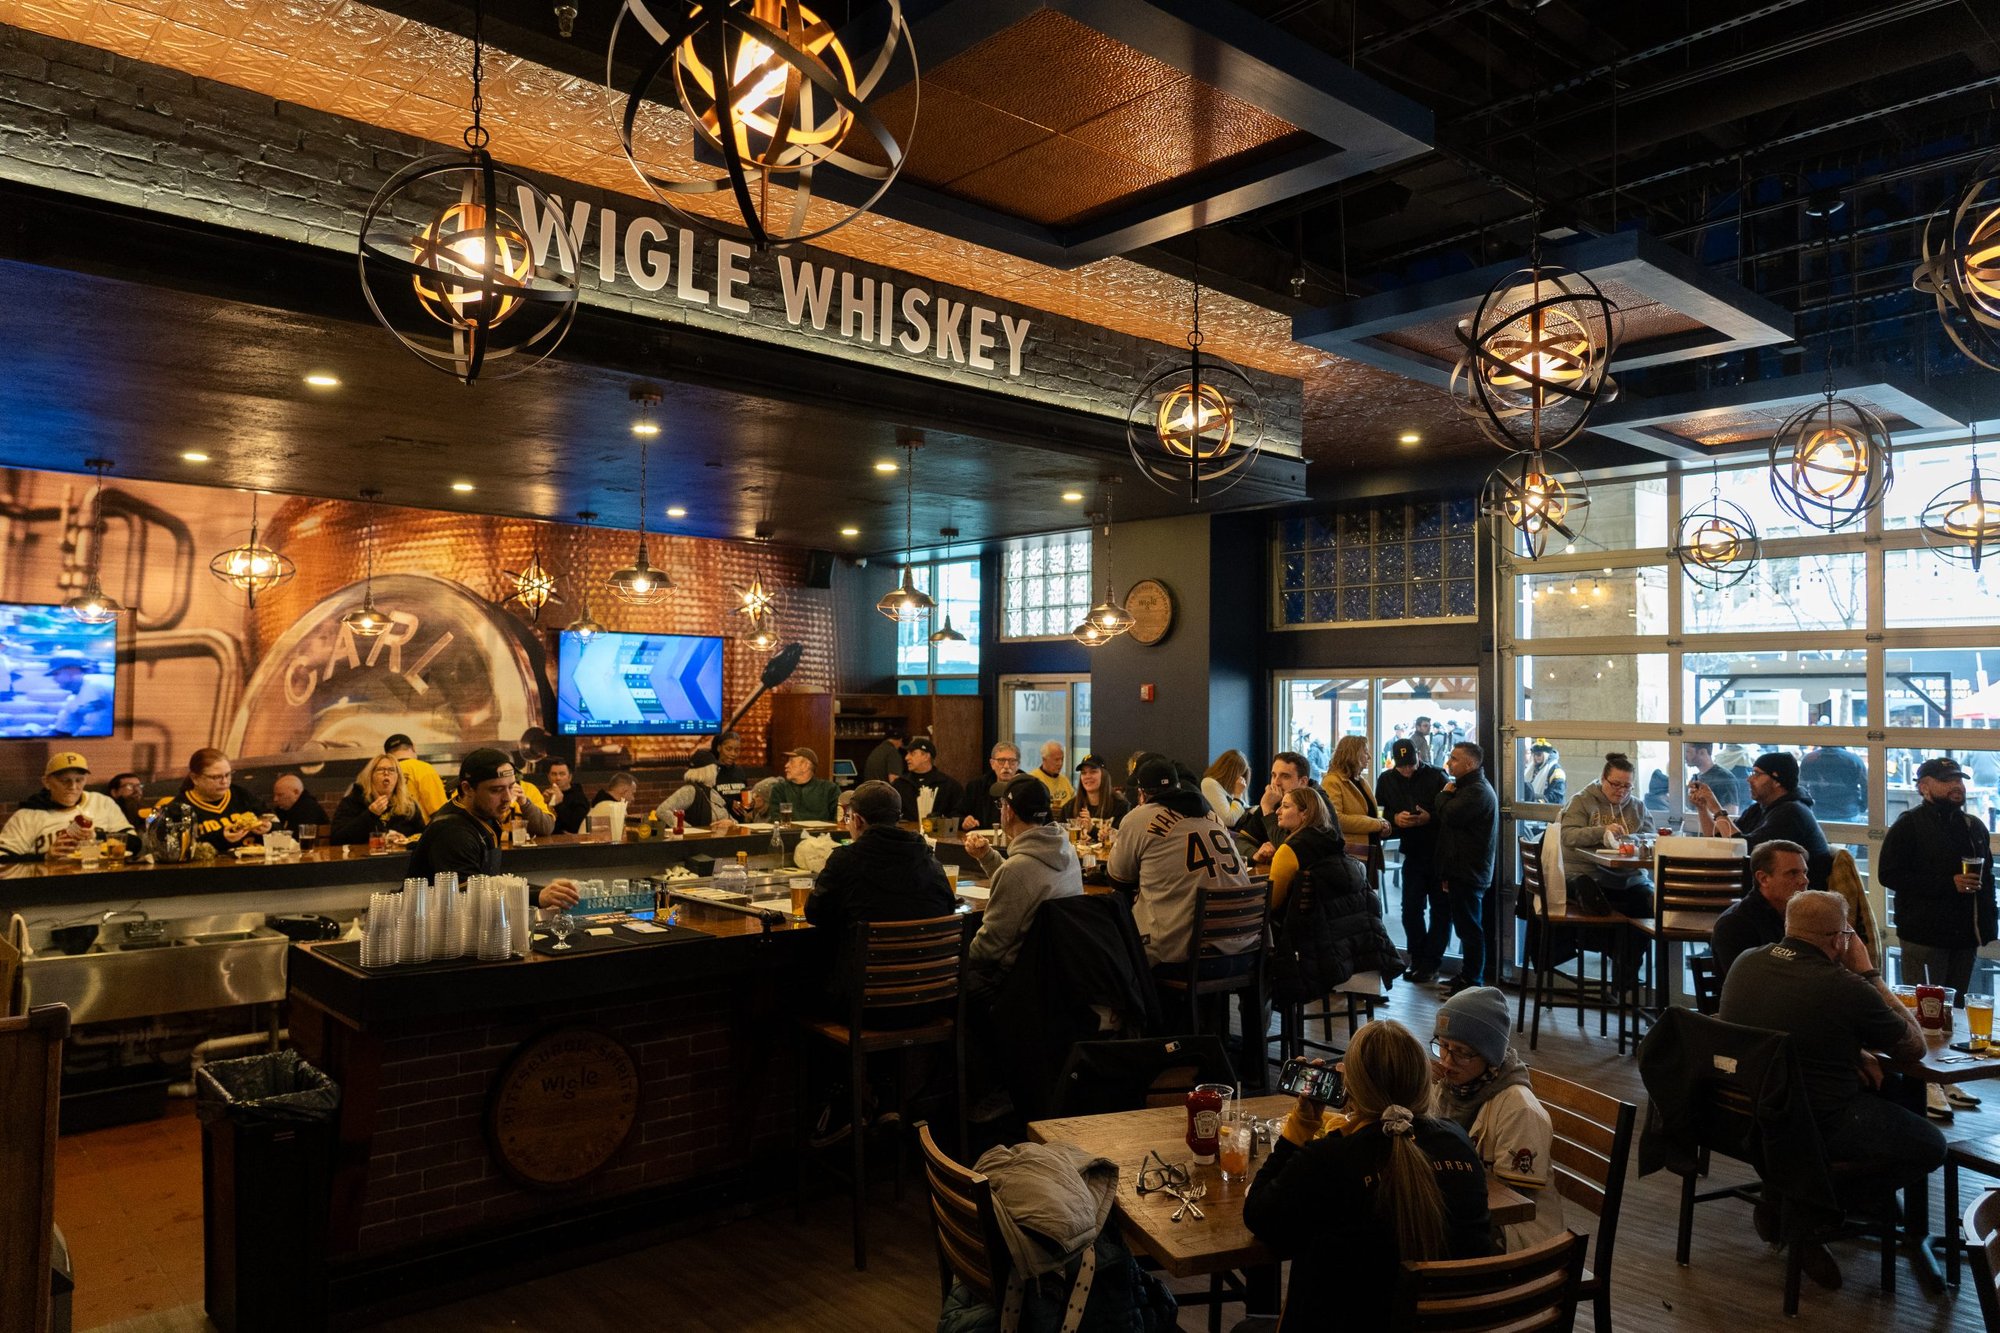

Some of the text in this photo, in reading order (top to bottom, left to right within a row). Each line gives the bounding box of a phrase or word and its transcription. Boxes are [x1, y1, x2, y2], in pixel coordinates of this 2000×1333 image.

[516, 184, 1031, 377] WIGLE WHISKEY
[67, 755, 77, 765] P
[1399, 747, 1407, 757] P
[1186, 828, 1240, 880] 49
[1363, 1160, 1474, 1188] PIURGH
